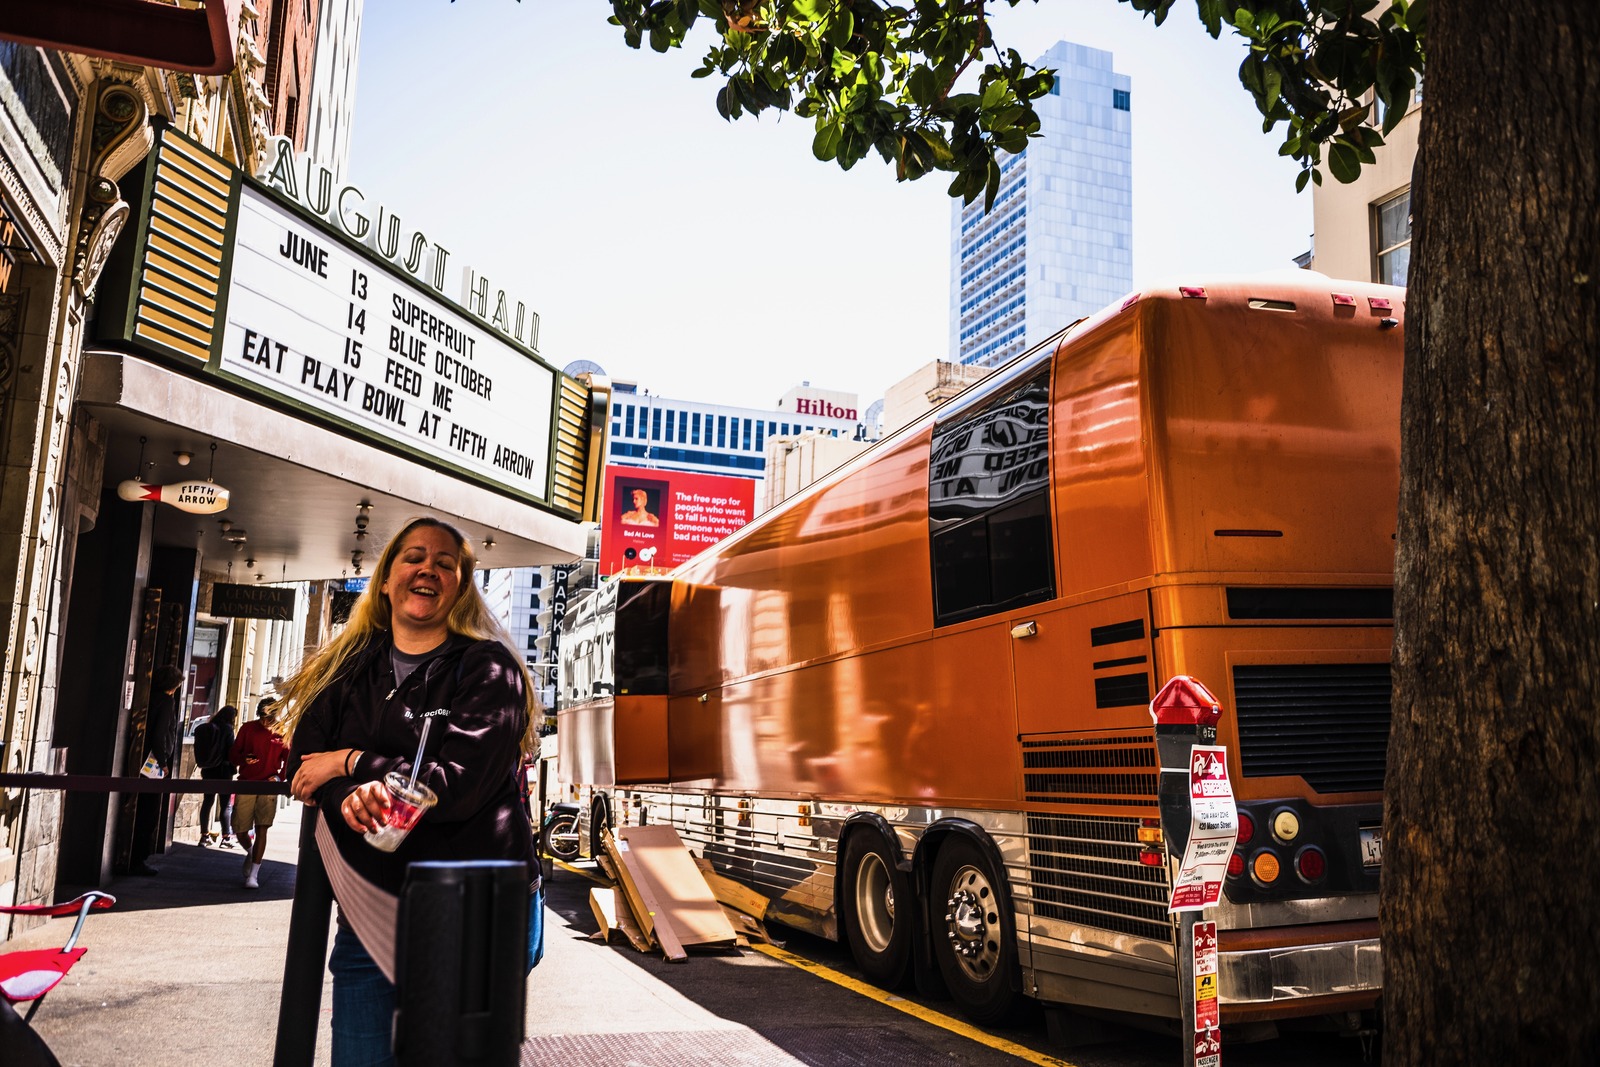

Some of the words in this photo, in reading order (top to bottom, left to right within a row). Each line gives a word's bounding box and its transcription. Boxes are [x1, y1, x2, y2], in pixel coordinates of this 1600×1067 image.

[266, 138, 451, 293] AUGUST
[468, 269, 541, 354] HALL
[279, 230, 328, 280] JUNE
[351, 268, 368, 301] 13
[392, 292, 475, 361] SUPERFRUIT
[347, 302, 366, 336] 14
[389, 325, 427, 367] BLUE
[435, 350, 492, 401] OCTOBER
[343, 337, 363, 369] 15
[385, 357, 422, 398] FEED
[432, 381, 454, 413] ME
[242, 328, 289, 374] EAT
[301, 355, 355, 402] PLAY
[362, 382, 406, 427] BOWL
[418, 410, 441, 440] AT
[449, 422, 488, 461] FIFTH
[493, 444, 534, 480] ARROW
[796, 398, 858, 421] Hilton
[182, 485, 215, 496] FIFTH
[178, 494, 217, 505] ARROW
[676, 491, 692, 502] The
[693, 494, 710, 504] free
[711, 497, 727, 506] app
[728, 497, 741, 506] for
[675, 503, 704, 513] people
[705, 505, 724, 514] who
[725, 508, 746, 517] want
[674, 512, 684, 520] to
[685, 512, 698, 522] fall
[700, 513, 708, 523] in
[709, 515, 726, 524] love
[727, 517, 746, 526] with
[673, 523, 713, 533] someone
[714, 526, 733, 536] who
[673, 531, 690, 541] bad
[691, 534, 700, 542] at
[701, 534, 719, 543] love
[226, 588, 281, 602] GENERAL
[219, 602, 289, 616] ADMISSION
[1197, 1054, 1219, 1067] PASSENGER
